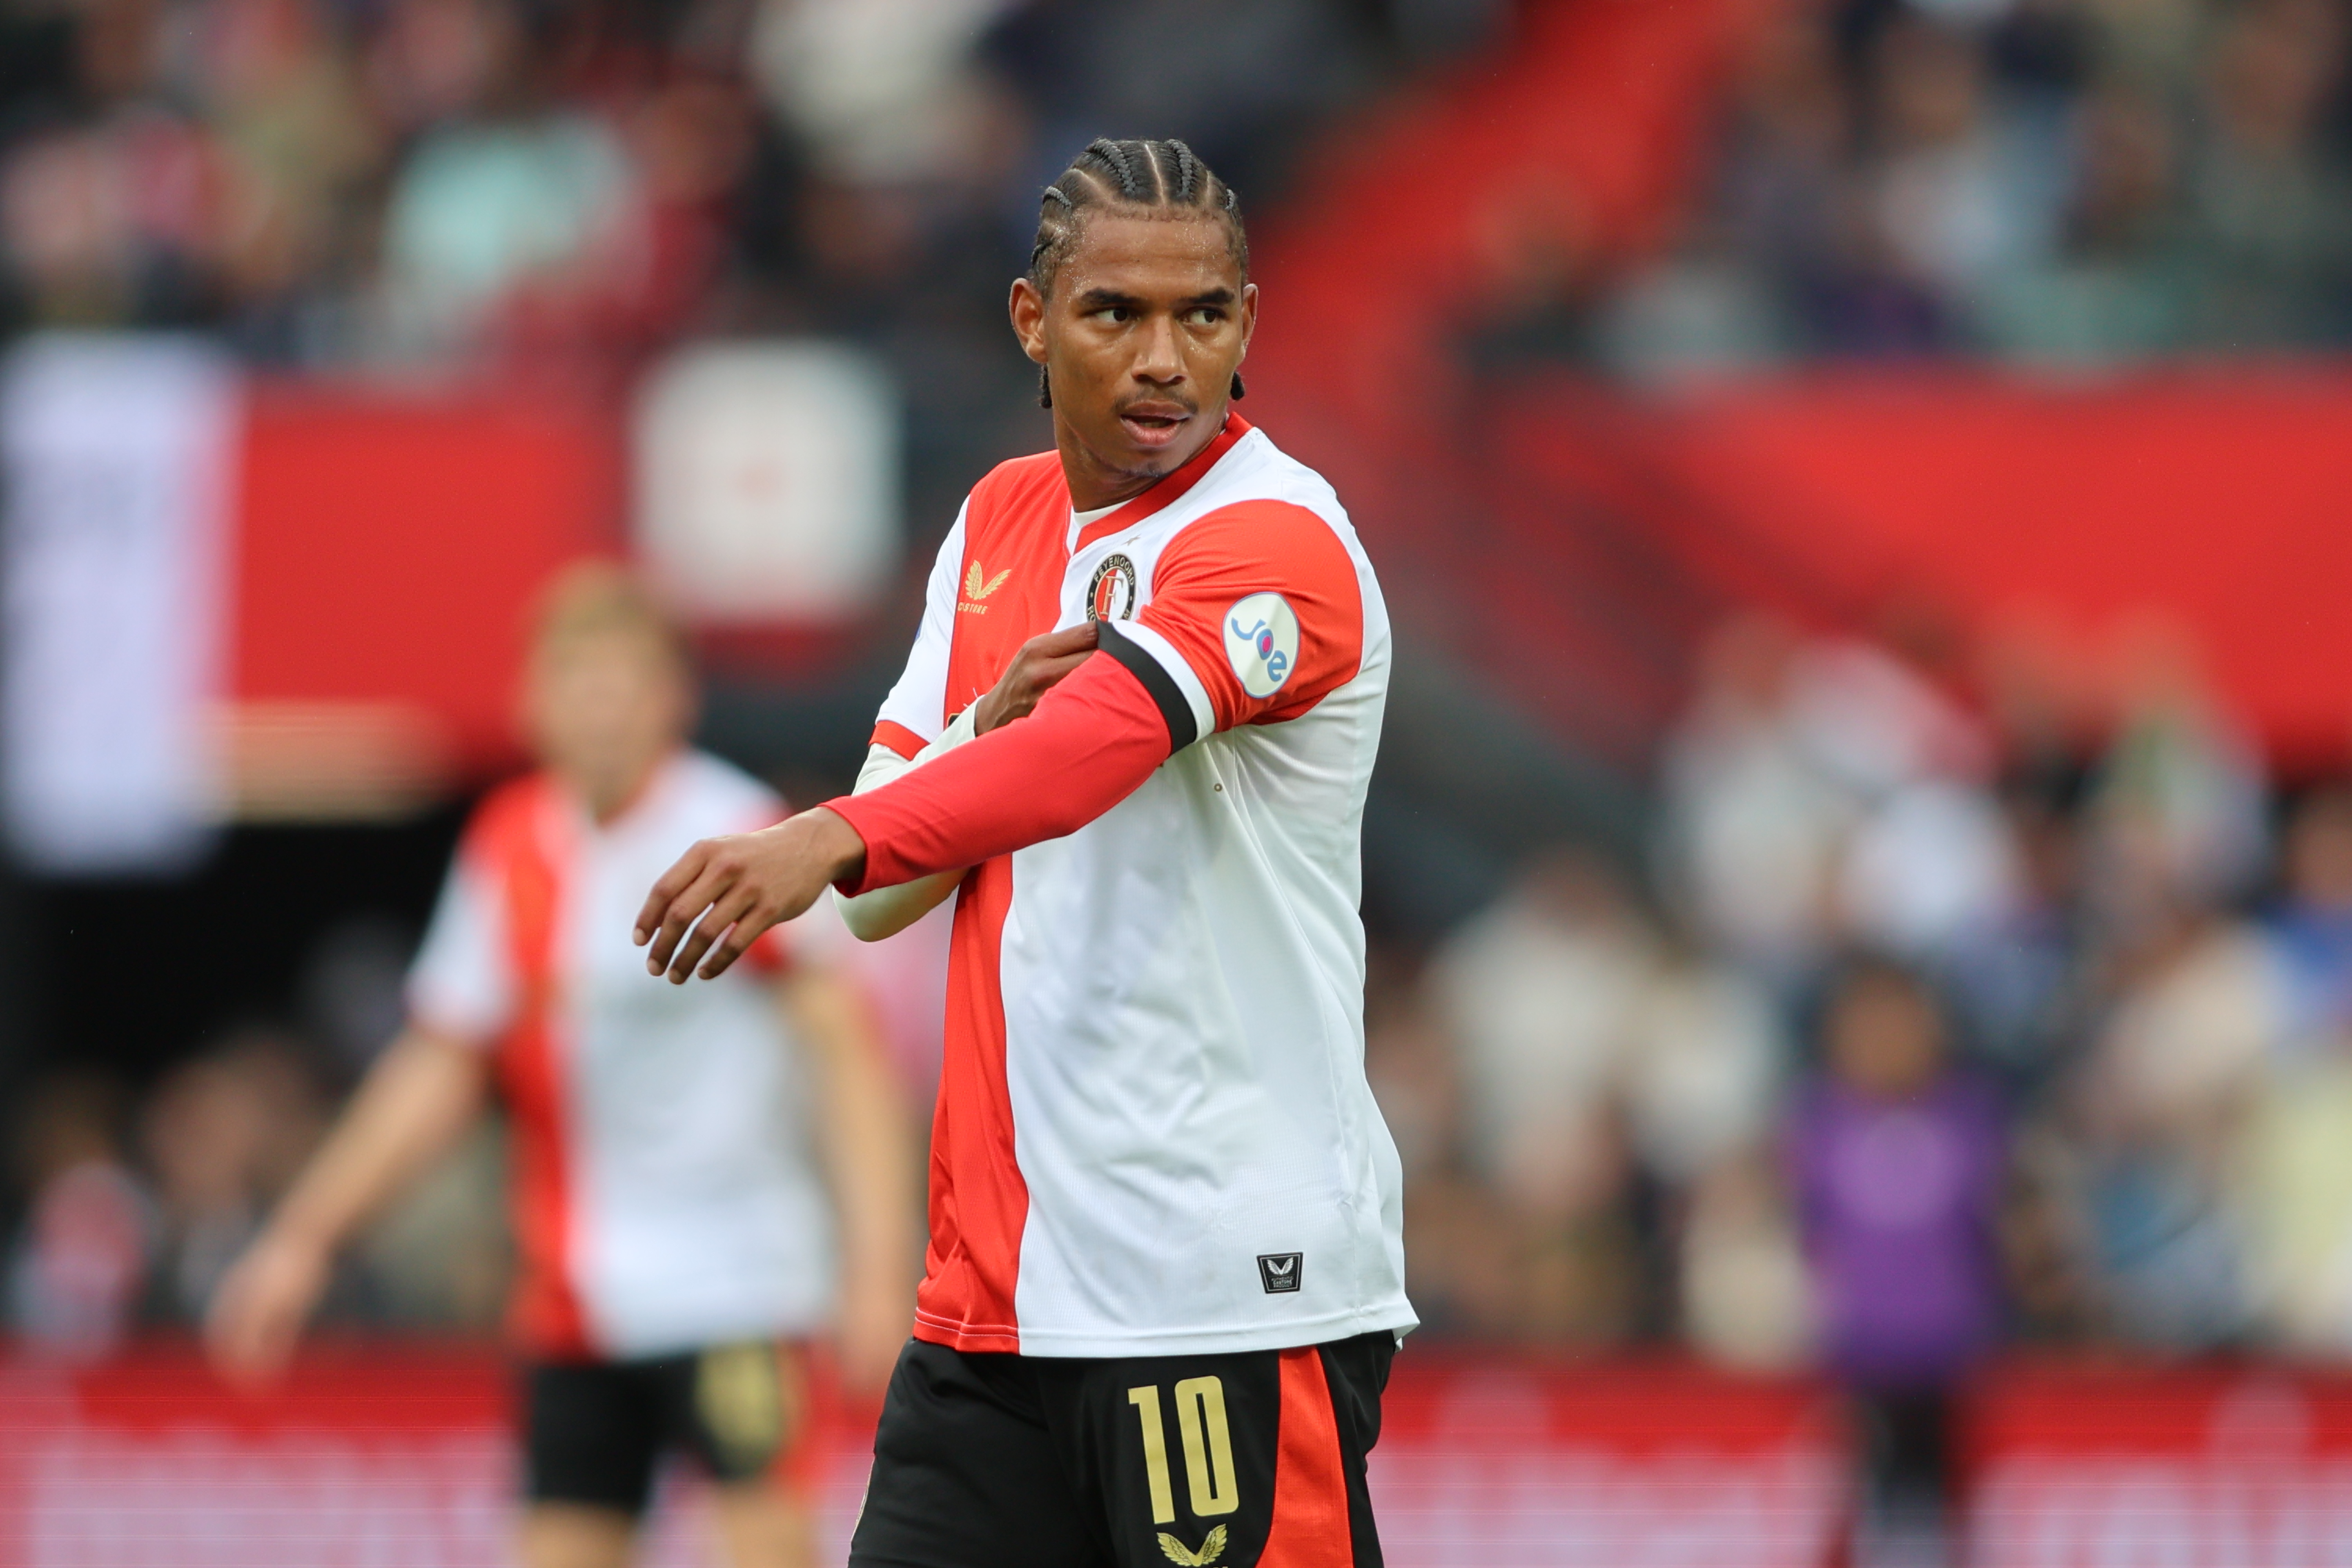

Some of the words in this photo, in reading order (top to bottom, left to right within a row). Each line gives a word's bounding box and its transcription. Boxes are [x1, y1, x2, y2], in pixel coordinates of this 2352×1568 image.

[1094, 555, 1134, 586] FEYENOORD
[1100, 575, 1124, 615] F
[1128, 1375, 1239, 1524] 10
